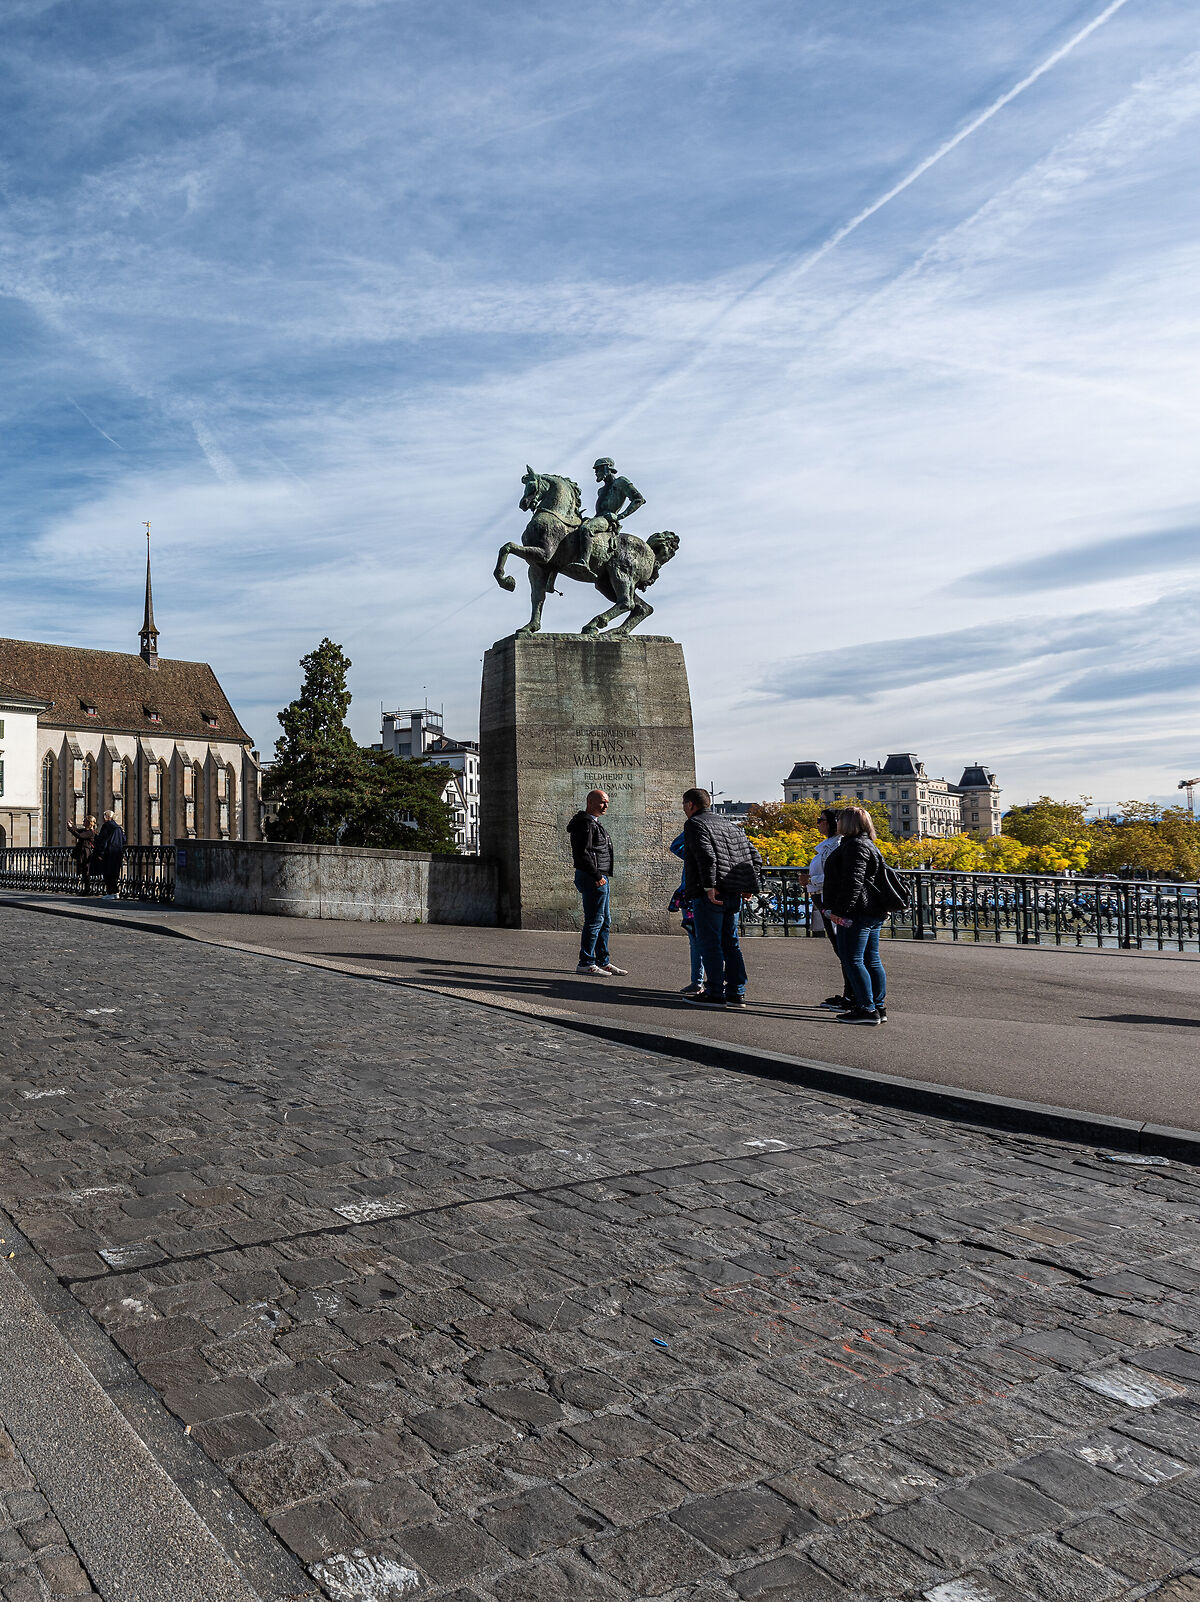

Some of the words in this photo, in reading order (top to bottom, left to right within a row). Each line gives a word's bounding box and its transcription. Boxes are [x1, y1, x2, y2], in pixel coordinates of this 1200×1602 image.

[590, 739, 624, 752] HANS
[573, 754, 642, 767] WALDMANN
[584, 773, 624, 781] FELDHERR
[584, 783, 633, 791] STAATSMANN
